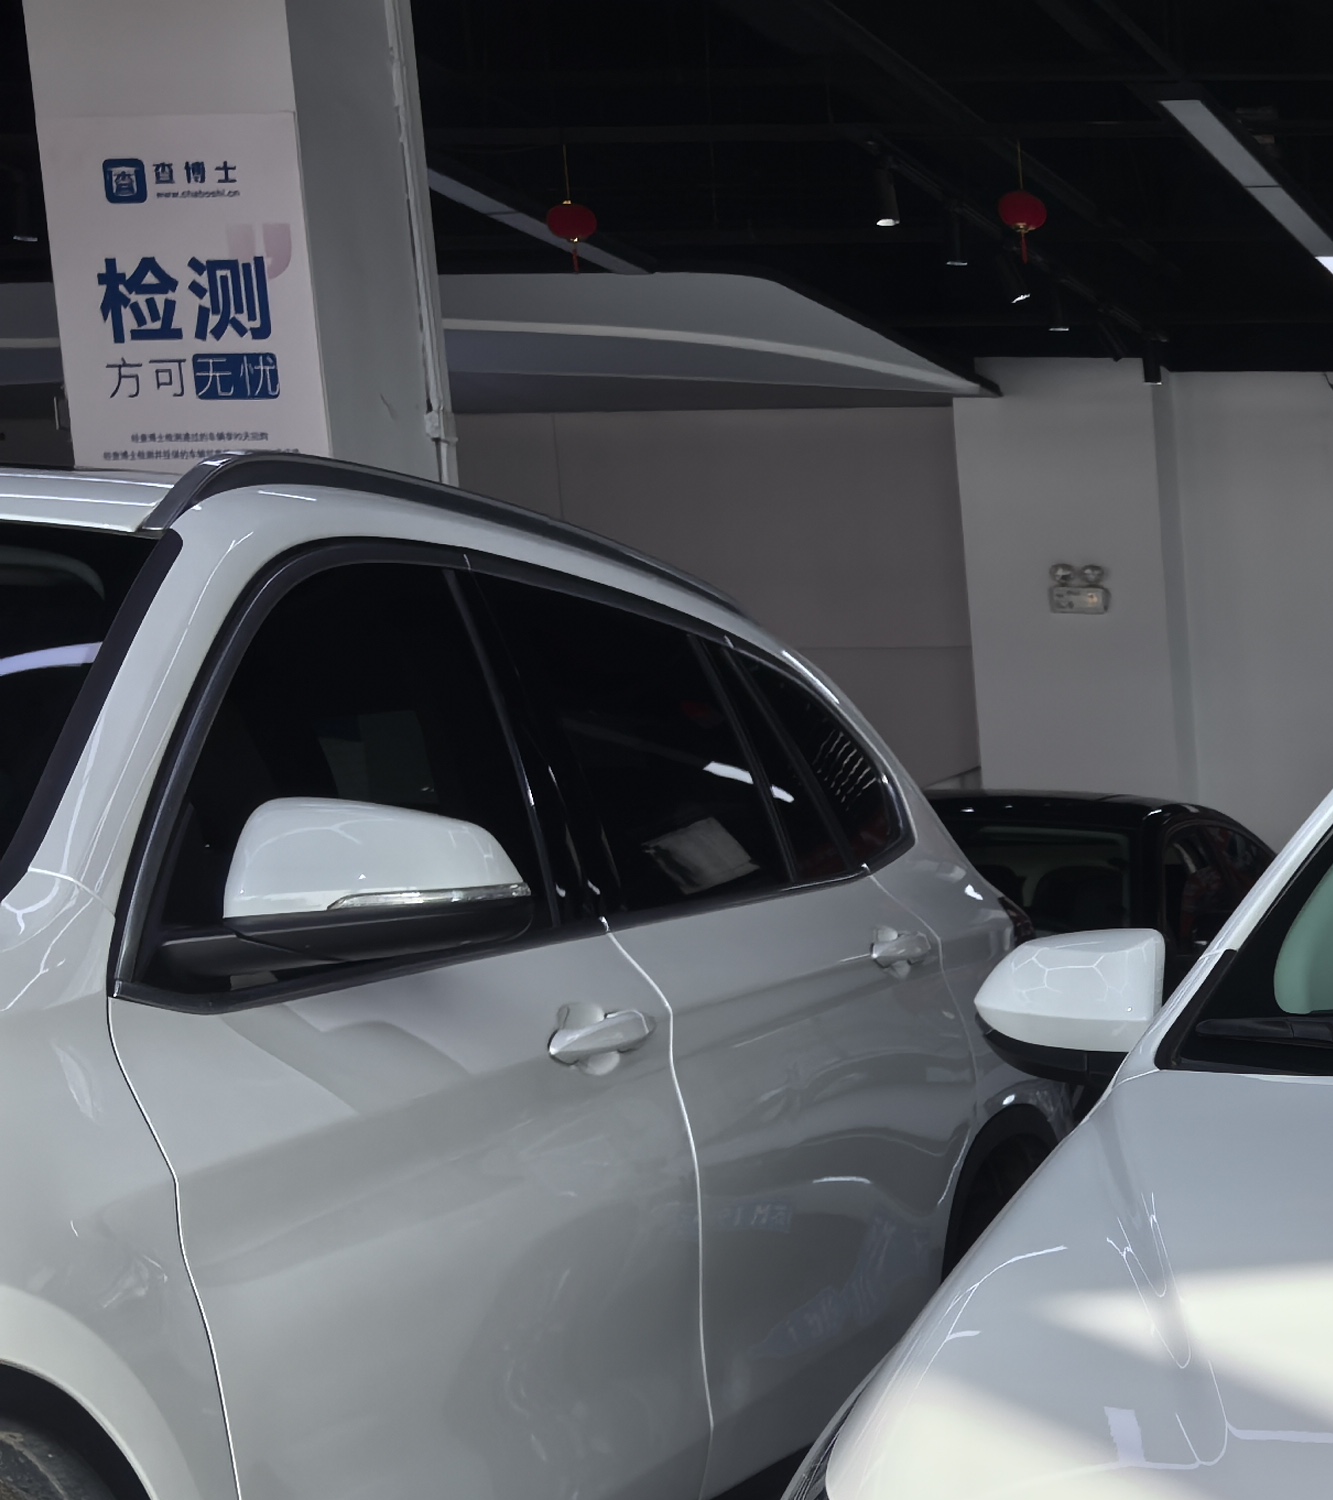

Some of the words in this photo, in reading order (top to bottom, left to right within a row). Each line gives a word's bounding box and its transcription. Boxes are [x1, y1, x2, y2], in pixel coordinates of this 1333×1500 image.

[153, 161, 237, 184] 查博士
[97, 256, 272, 343] 检测
[105, 356, 281, 399] 方可无忧
